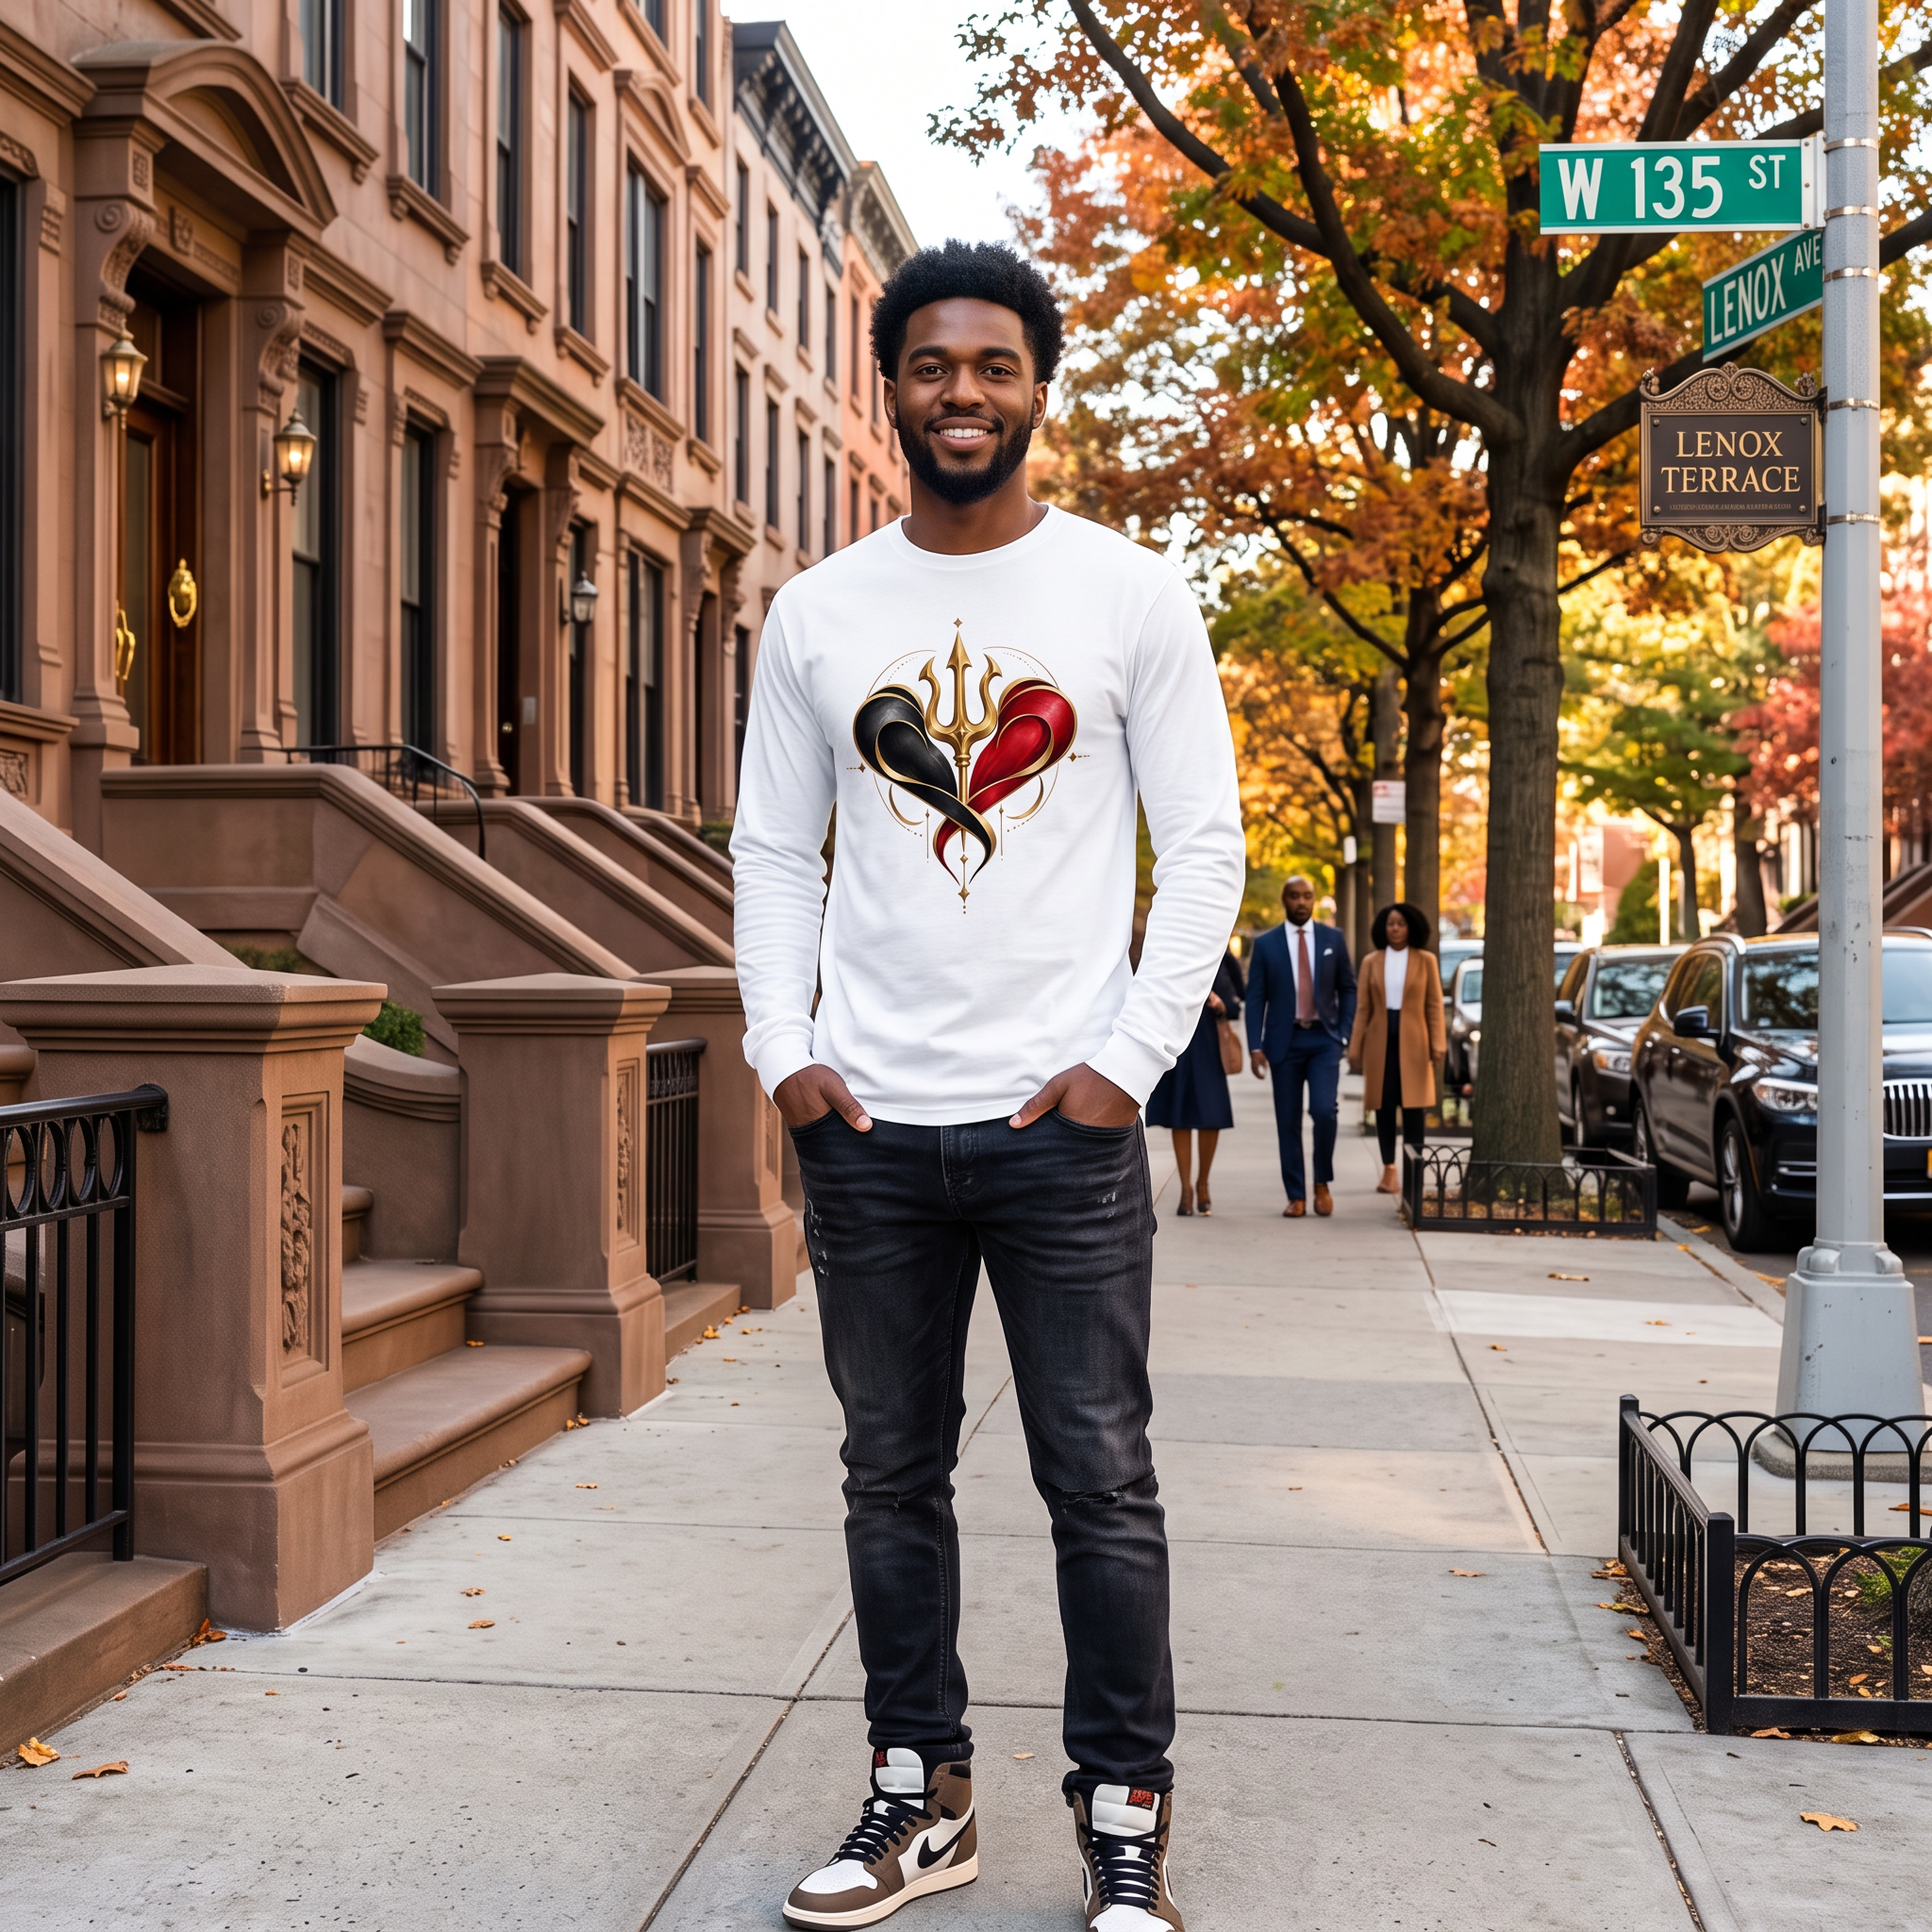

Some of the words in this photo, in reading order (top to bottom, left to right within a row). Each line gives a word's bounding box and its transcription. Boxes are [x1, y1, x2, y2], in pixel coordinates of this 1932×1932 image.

[1557, 158, 1604, 220] W
[1630, 156, 1724, 219] 135
[1748, 154, 1786, 190] ST
[1710, 253, 1787, 344] LENOX
[1793, 233, 1822, 275] AVE
[1675, 430, 1784, 458] LENOX
[1660, 466, 1801, 493] TERRACE
